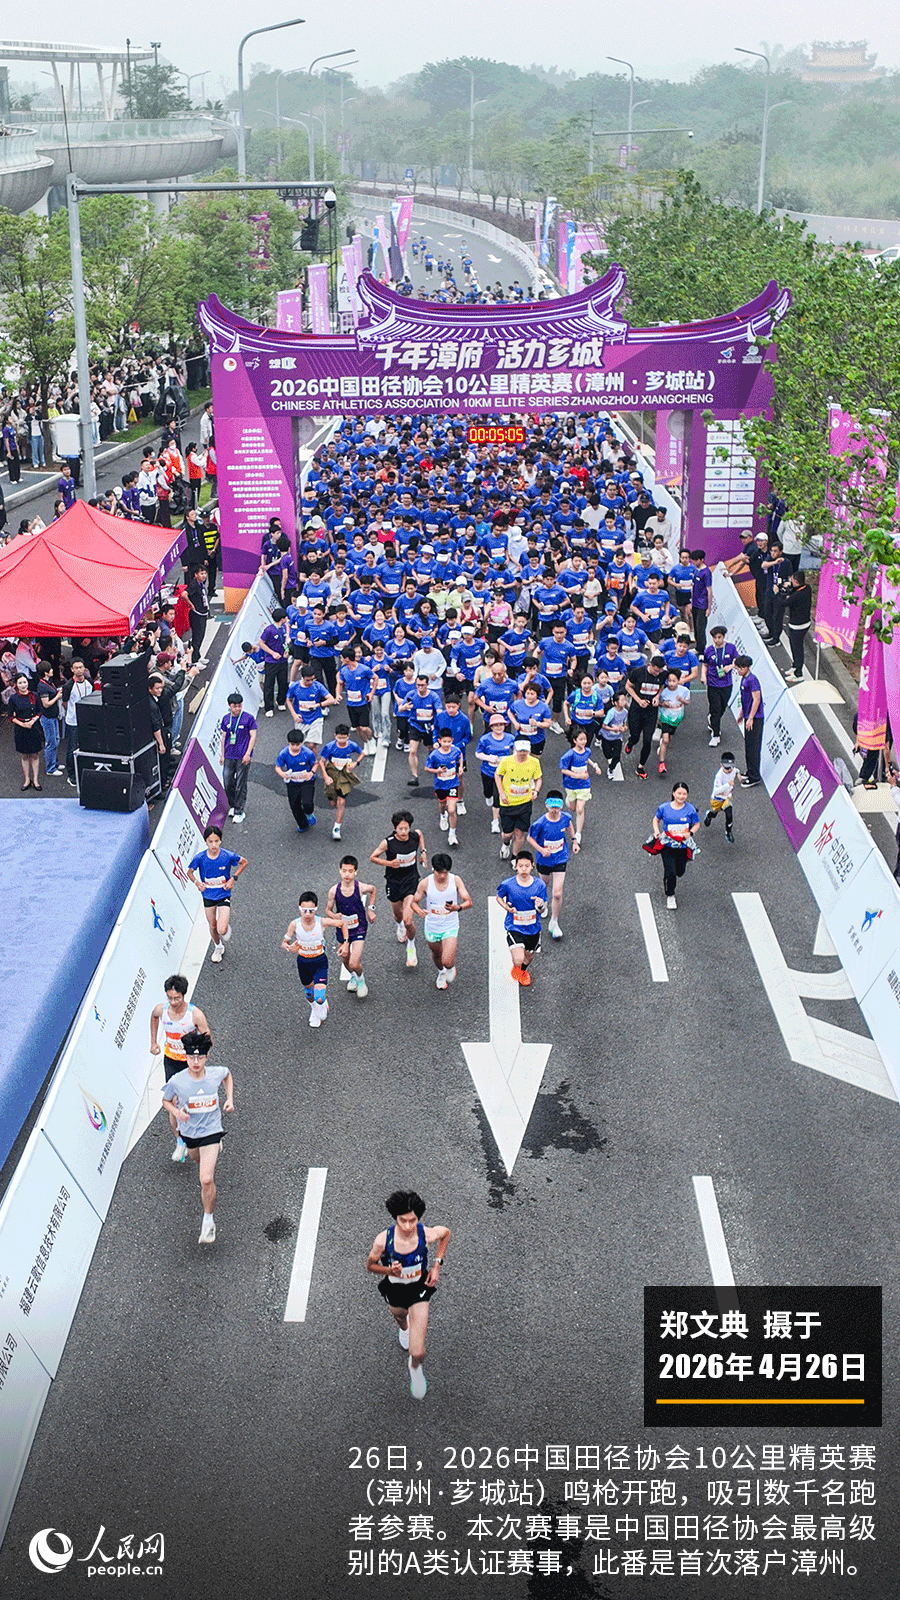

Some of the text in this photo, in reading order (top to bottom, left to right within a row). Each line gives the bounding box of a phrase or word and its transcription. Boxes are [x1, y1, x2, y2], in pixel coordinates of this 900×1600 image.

[375, 337, 604, 372] 千年漳府 活力芗城
[271, 393, 714, 411] CHINESE ATHLETICS ASSOCIATION 10KM ELITE SERIES ZHANGZHOU XIANGCHENG
[469, 427, 523, 441] 00:05:05
[829, 836, 854, 883] 中田经纪
[19, 1184, 72, 1318] 福建云歌信息技术有限公司
